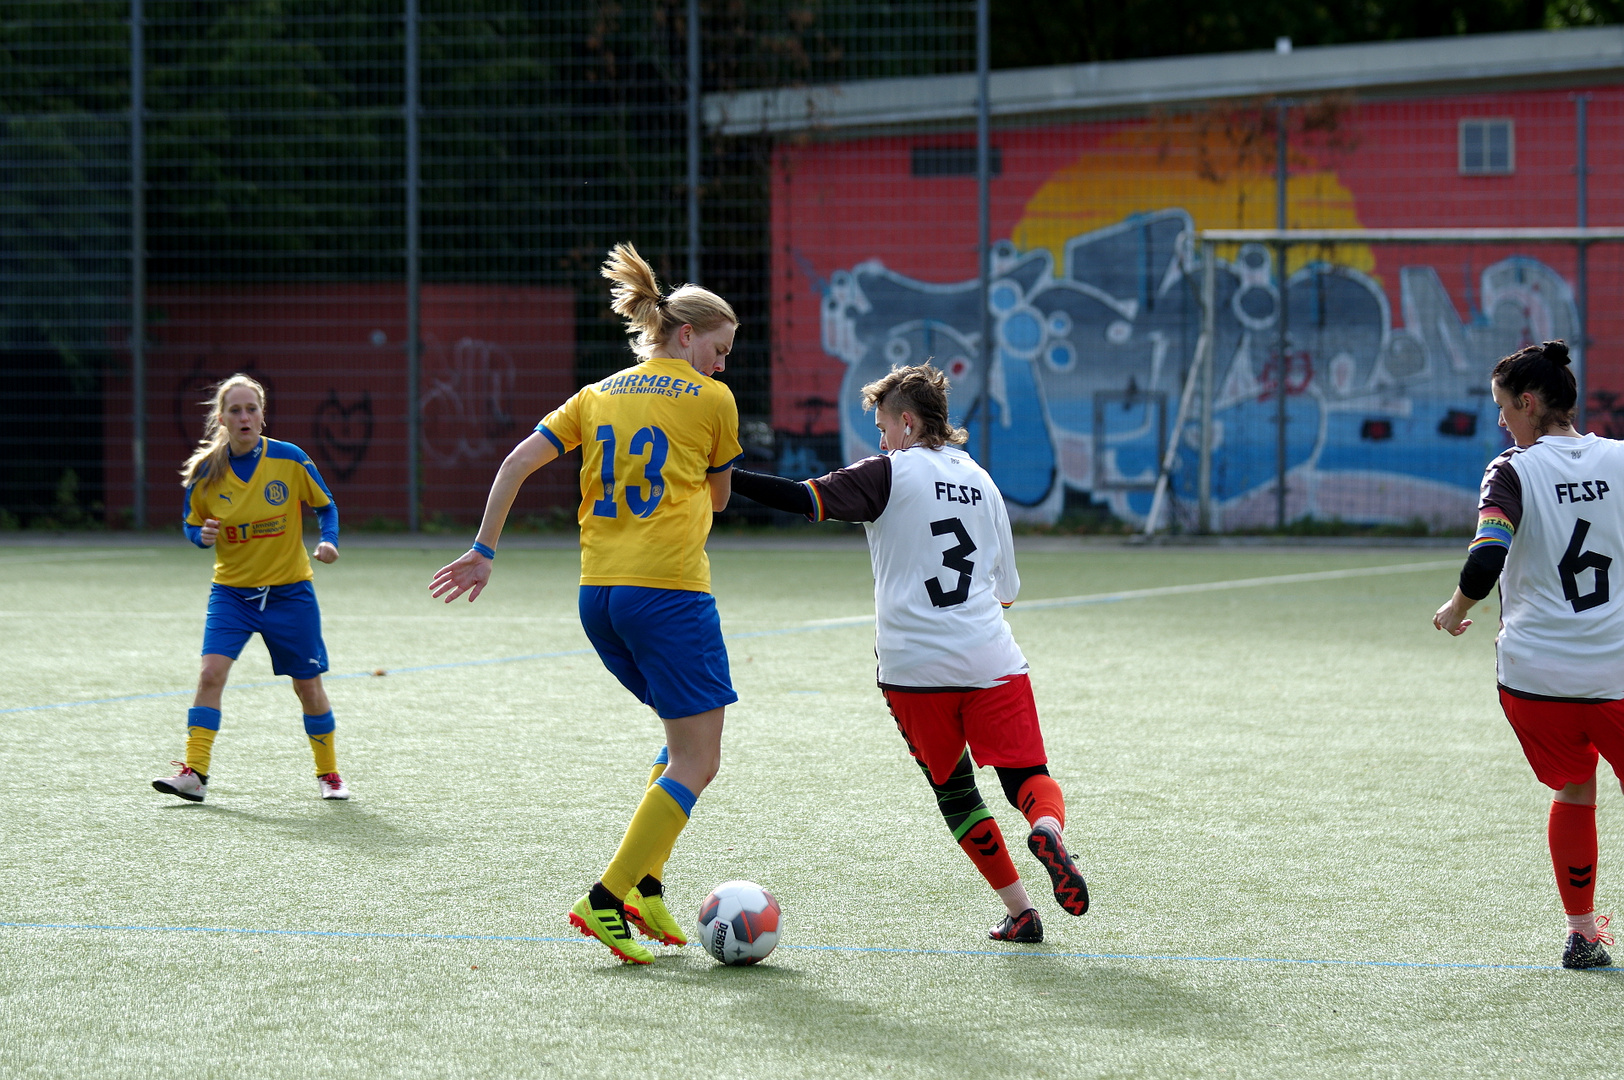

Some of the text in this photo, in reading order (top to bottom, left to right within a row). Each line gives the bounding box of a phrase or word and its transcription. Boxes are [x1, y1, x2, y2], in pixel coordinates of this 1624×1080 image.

[600, 374, 702, 397] BARMBEK
[610, 386, 681, 399] UHLENHORST
[593, 425, 669, 518] 13
[935, 481, 982, 506] FCSP
[1555, 480, 1610, 504] FCSP
[225, 523, 249, 540] BT
[924, 517, 977, 608] 3
[1558, 518, 1613, 613] 6
